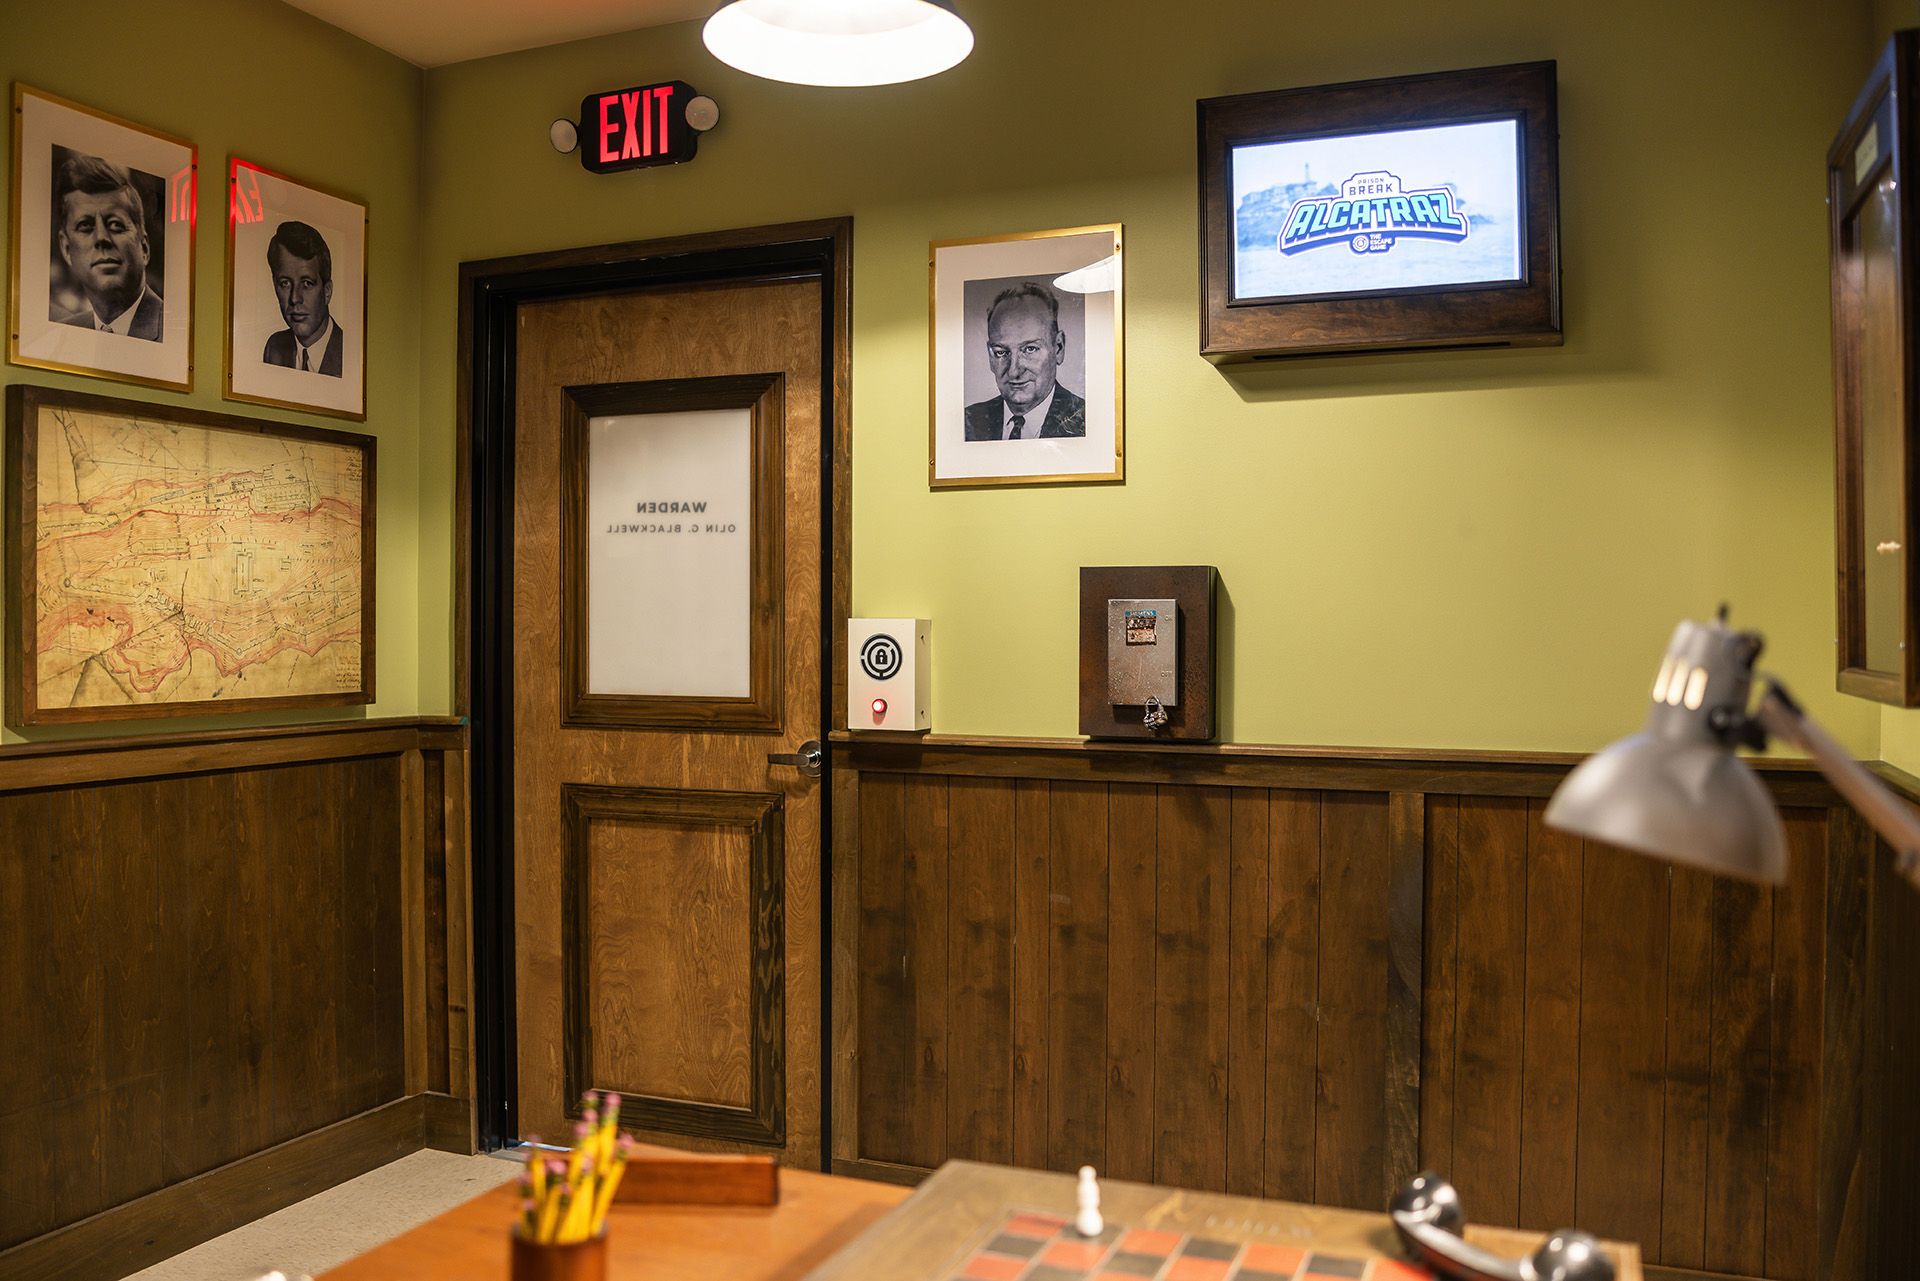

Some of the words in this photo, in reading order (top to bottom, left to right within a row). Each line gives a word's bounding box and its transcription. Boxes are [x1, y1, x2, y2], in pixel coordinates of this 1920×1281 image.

[600, 85, 674, 163] EXIT
[1349, 183, 1393, 196] BREAK
[1286, 193, 1462, 240] ALCATRAZ
